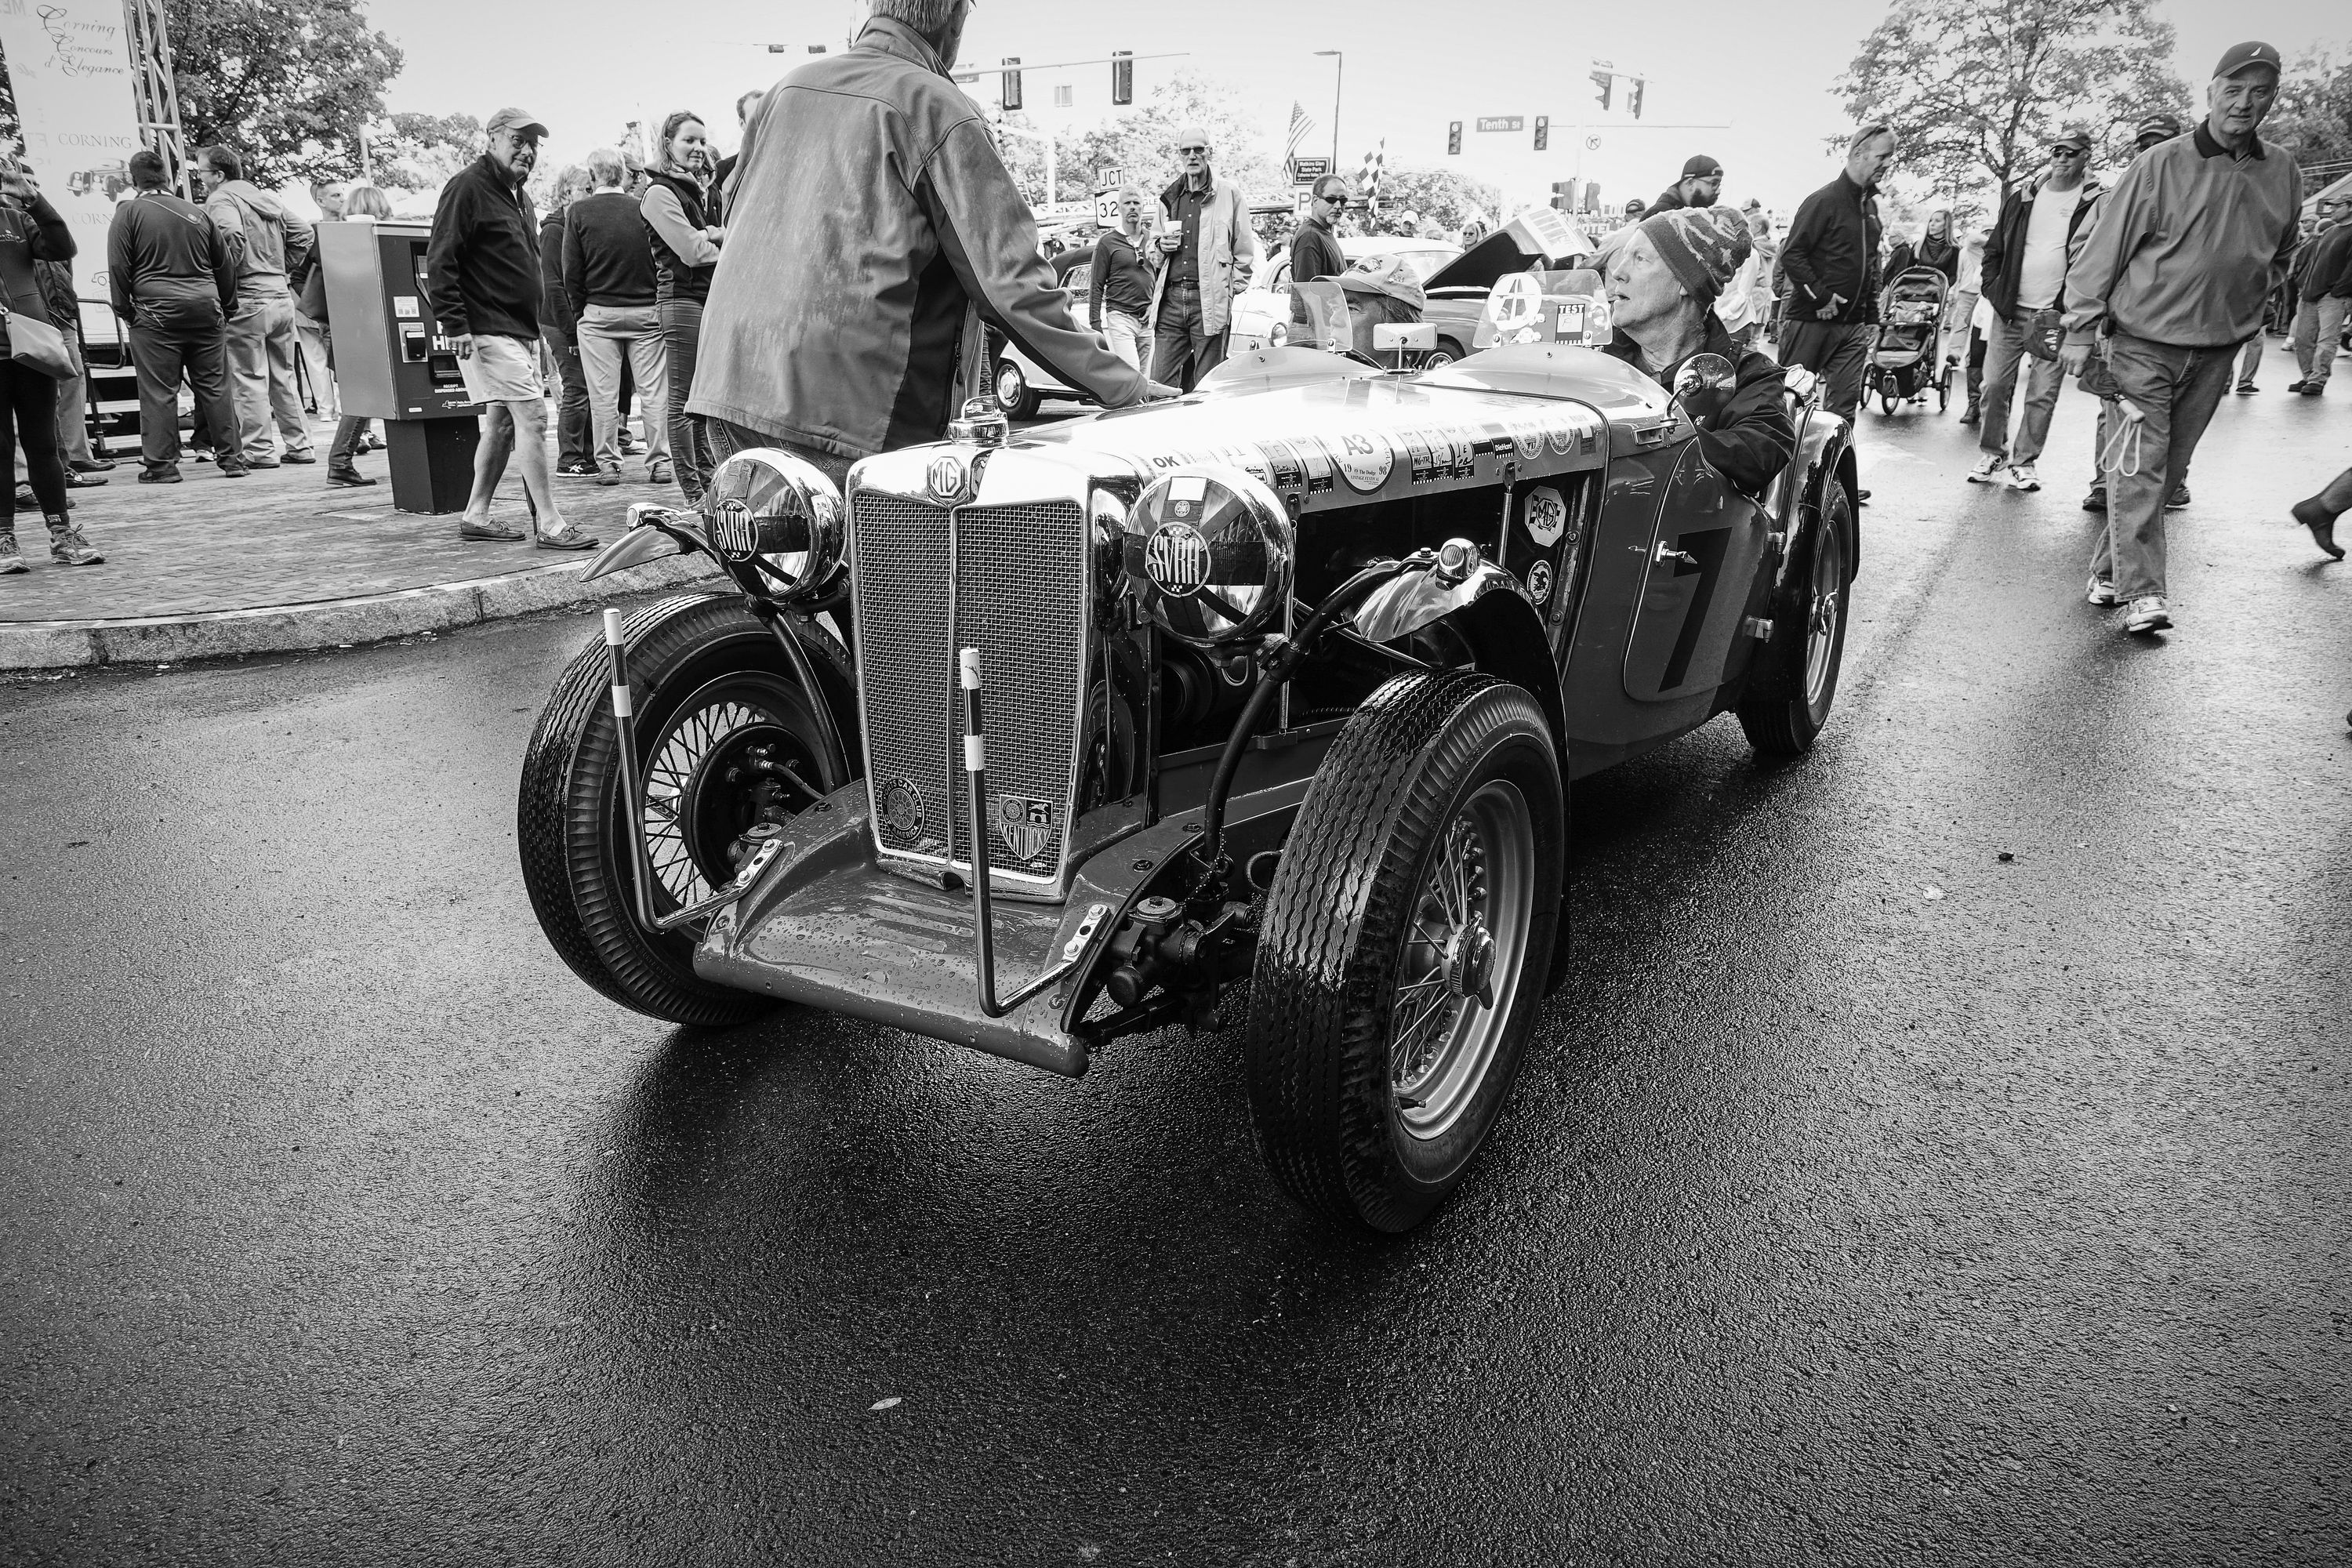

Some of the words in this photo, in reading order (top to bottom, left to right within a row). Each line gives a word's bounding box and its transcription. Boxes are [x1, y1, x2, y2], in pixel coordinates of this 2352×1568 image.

[37, 5, 116, 41] Corning
[52, 34, 113, 58] Concours
[1479, 118, 1509, 130] Tenth
[58, 132, 132, 149] CORNING
[1102, 169, 1122, 187] JCT
[1559, 304, 1584, 314] TEST
[1341, 434, 1374, 456] A3
[1494, 442, 1512, 452] DieHard
[1152, 456, 1181, 468] OK
[1344, 463, 1352, 473] 19
[1379, 466, 1387, 475] 98
[932, 462, 958, 492] MG
[1537, 500, 1555, 528] MG
[717, 510, 753, 551] SVRA
[1153, 535, 1200, 585] SVRA
[1658, 526, 1733, 692] 7
[898, 779, 913, 794] CAR
[912, 793, 923, 818] CLUB
[884, 814, 892, 825] OF
[891, 825, 921, 840] AMERICA
[1003, 823, 1050, 857] KENTUCKY
